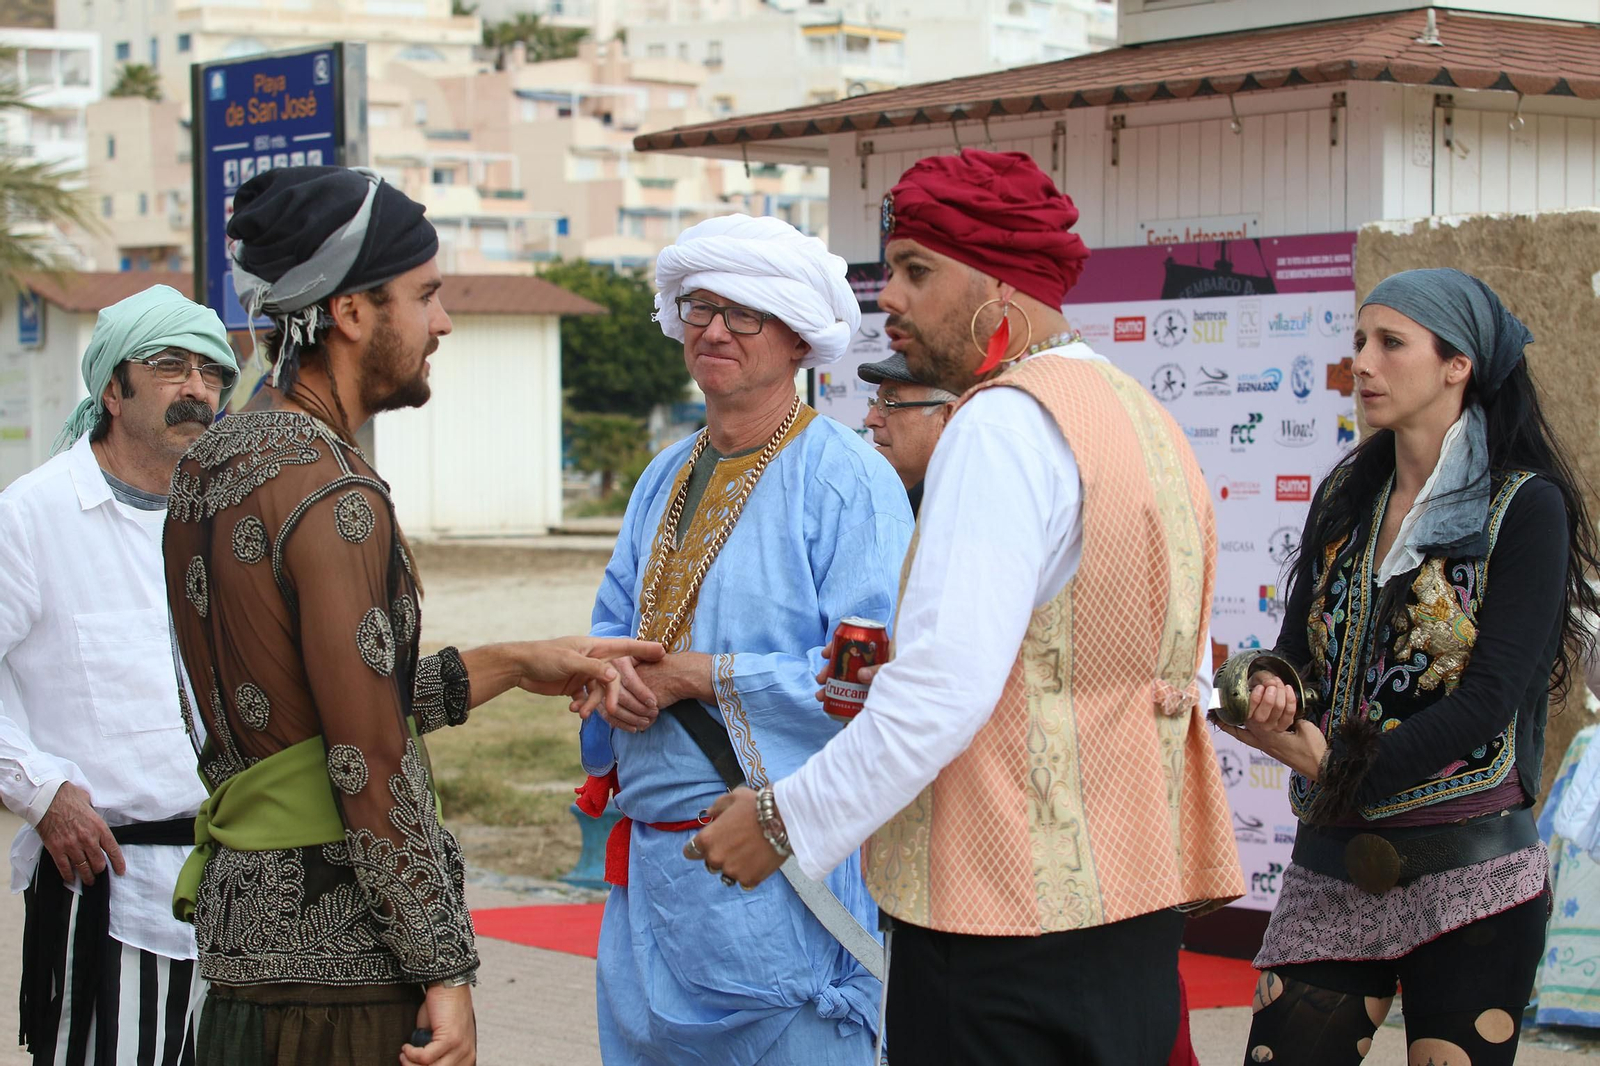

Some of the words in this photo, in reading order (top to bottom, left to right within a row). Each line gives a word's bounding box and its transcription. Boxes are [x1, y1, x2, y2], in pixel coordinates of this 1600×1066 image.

[253, 73, 286, 97] Playa
[225, 101, 245, 127] de
[247, 97, 277, 124] San
[281, 89, 317, 120] José
[1116, 321, 1143, 333] suma
[1193, 320, 1228, 344] sur
[1237, 381, 1279, 393] BERNARDO
[1231, 424, 1257, 444] FCC
[1281, 418, 1315, 438] Wow!
[1278, 480, 1309, 493] suma
[826, 681, 869, 700] Cruzcam
[1249, 766, 1285, 790] sur
[1252, 872, 1277, 894] FCC
